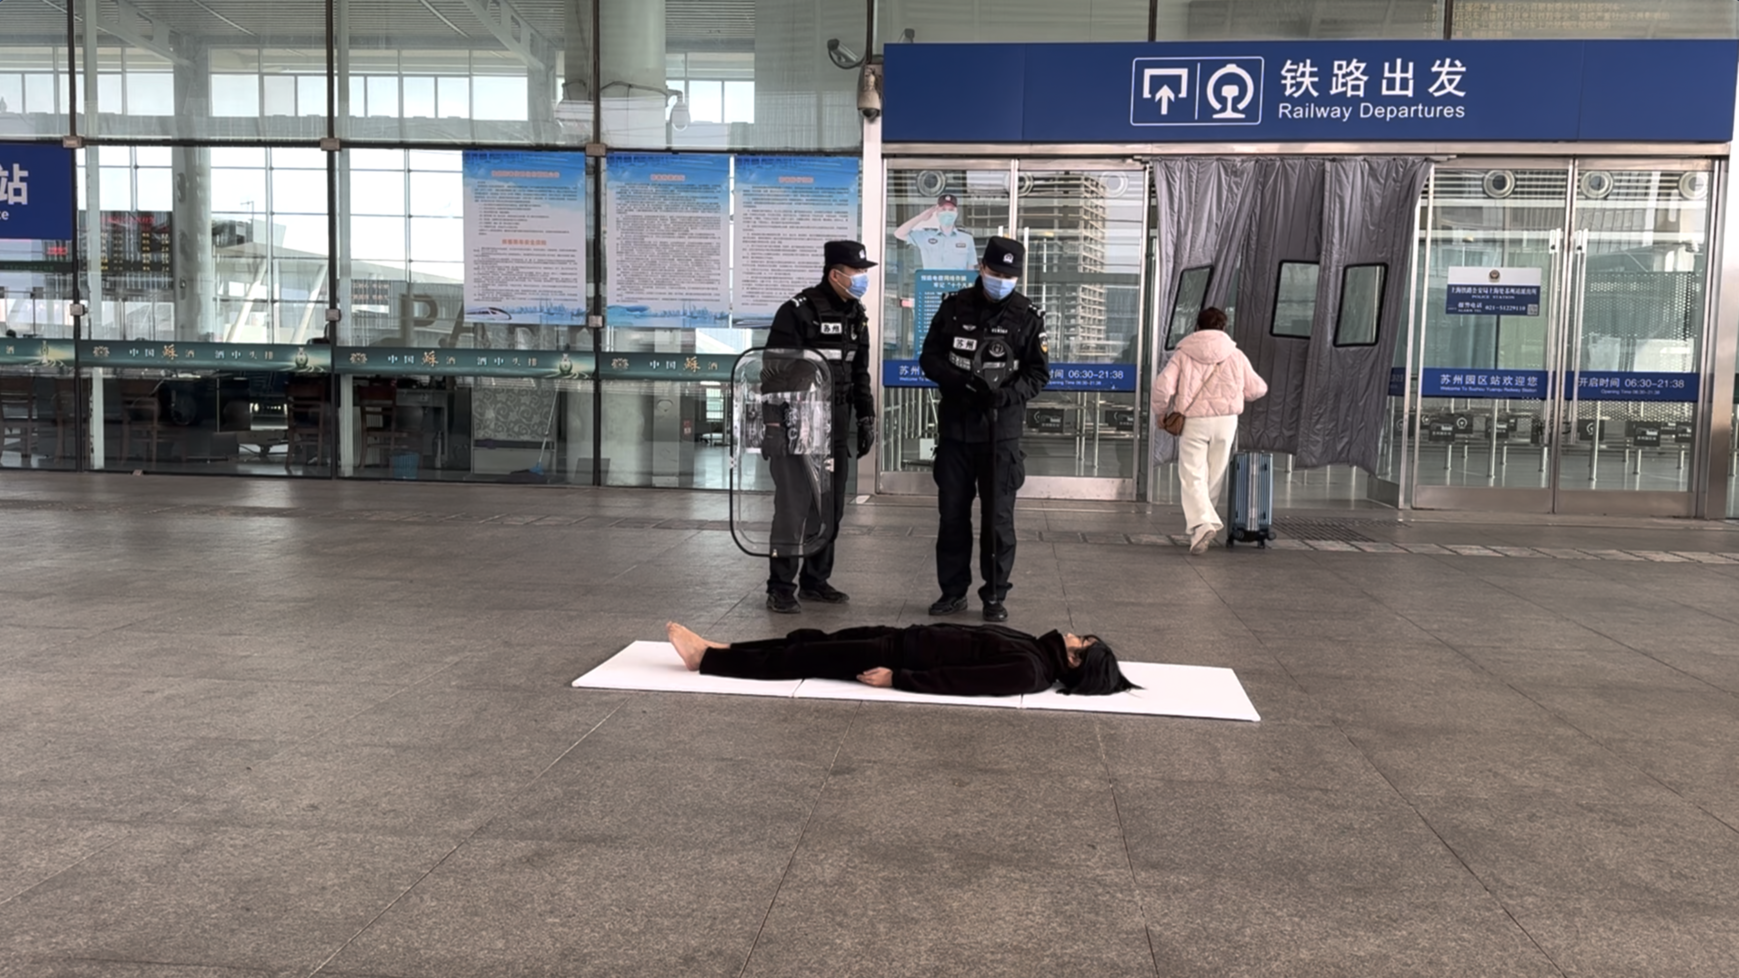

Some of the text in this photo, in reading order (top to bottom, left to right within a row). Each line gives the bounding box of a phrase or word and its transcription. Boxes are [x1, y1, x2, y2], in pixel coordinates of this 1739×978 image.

[1280, 58, 1467, 98] 铁路出发
[1278, 103, 1465, 121] Railway Departures
[957, 339, 975, 348] 苏州
[1068, 369, 1124, 379] 06:30-21:38
[1440, 374, 1538, 387] 苏州园区站欢迎您
[1579, 377, 1685, 389] 开启时间 06:30-21:38
